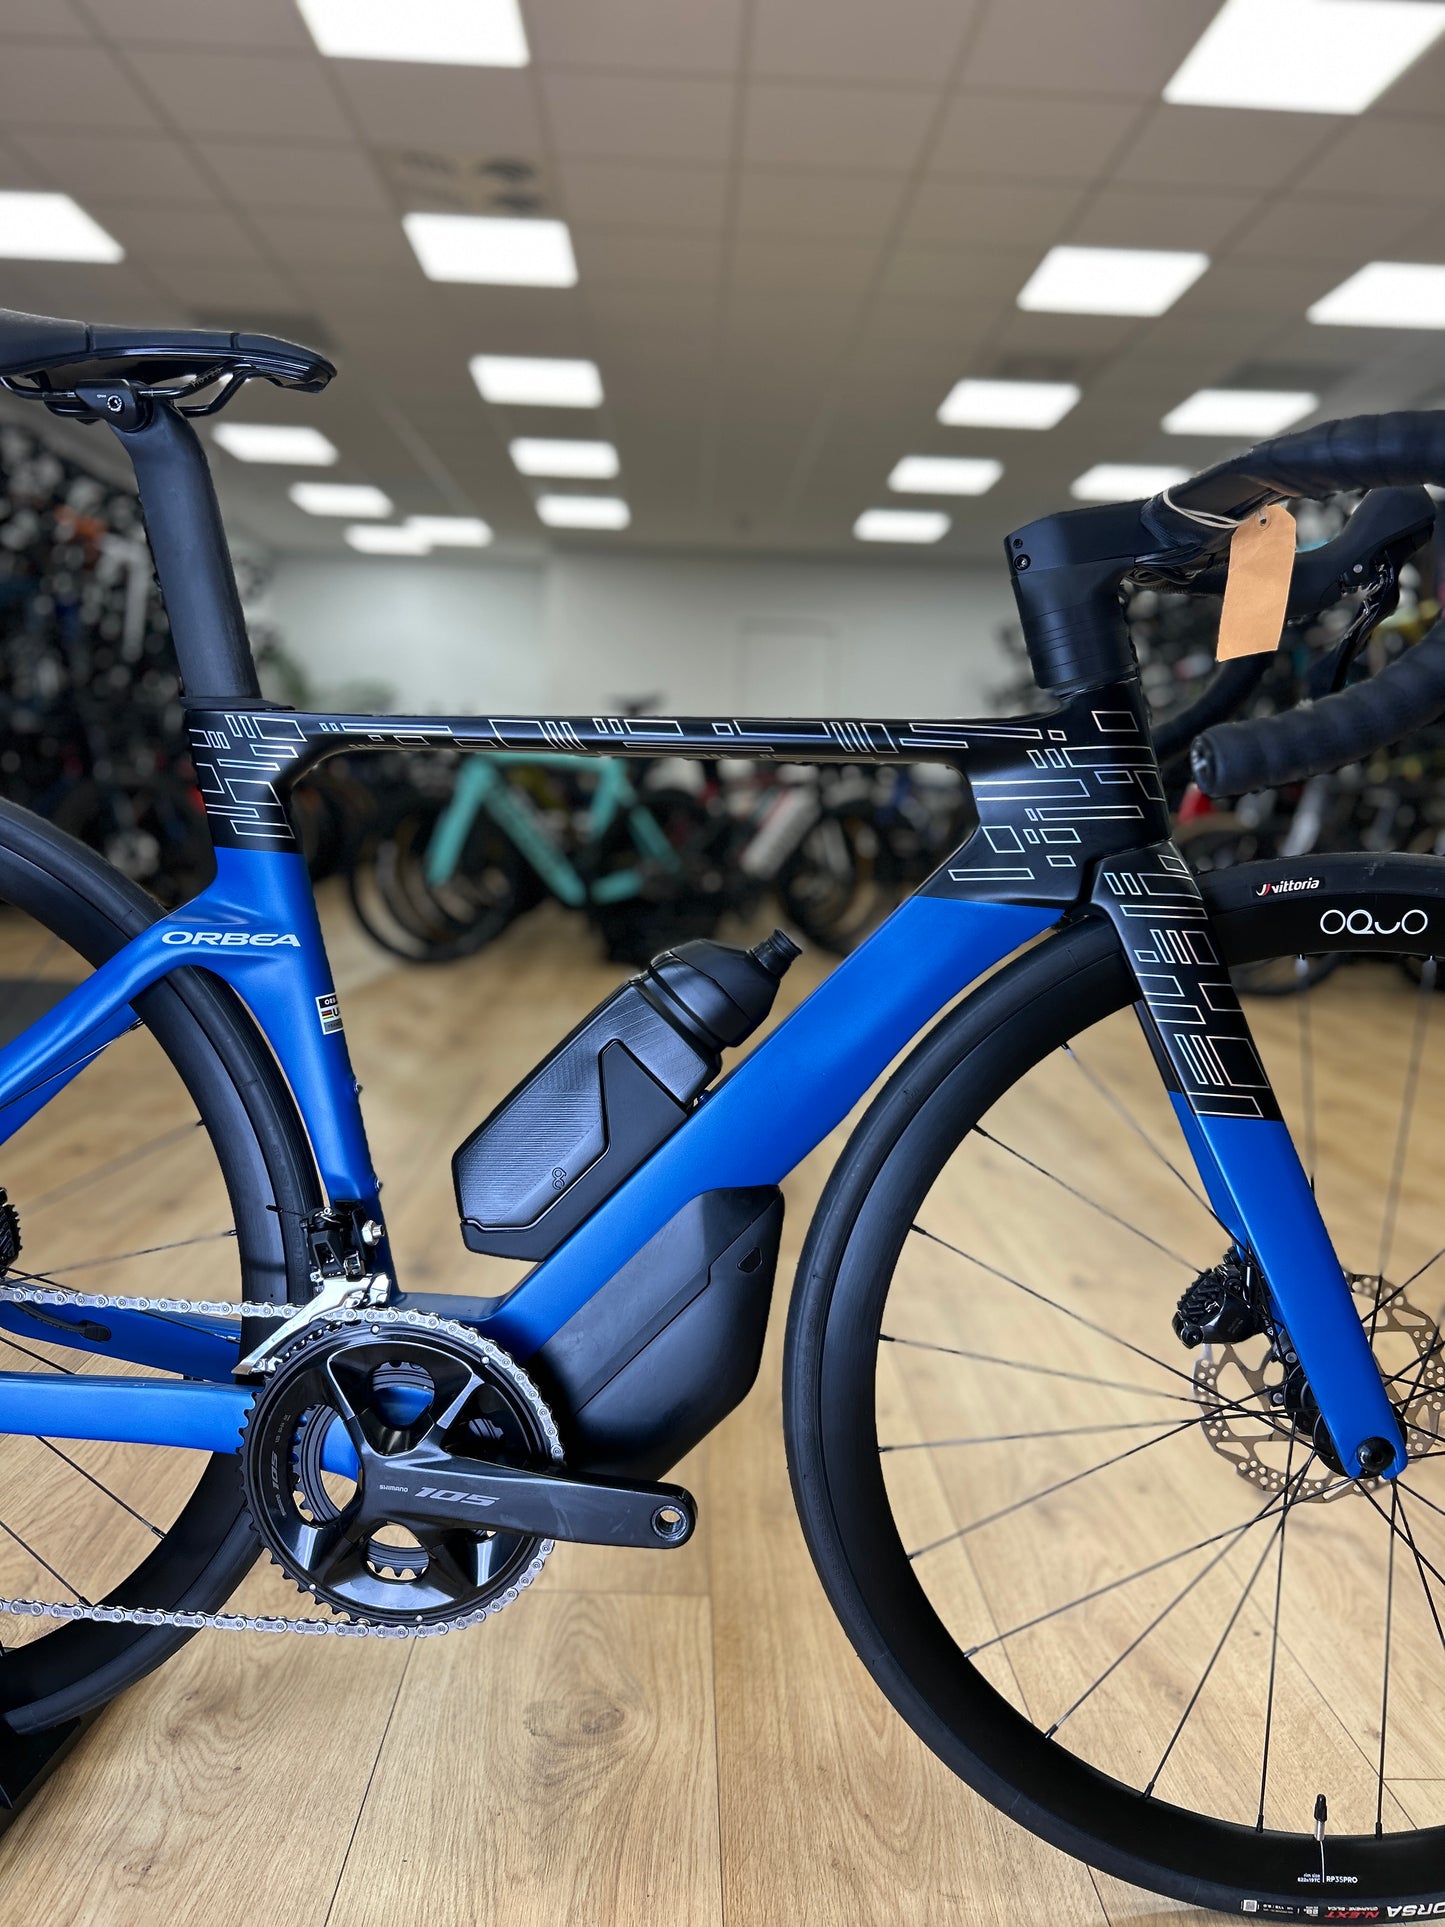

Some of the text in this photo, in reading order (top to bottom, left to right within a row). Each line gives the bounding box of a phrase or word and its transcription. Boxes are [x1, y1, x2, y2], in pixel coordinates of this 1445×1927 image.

[1271, 877, 1320, 894] vittoria
[1319, 909, 1428, 935] OQUO
[161, 931, 301, 947] ORBEA
[415, 1486, 501, 1507] 105
